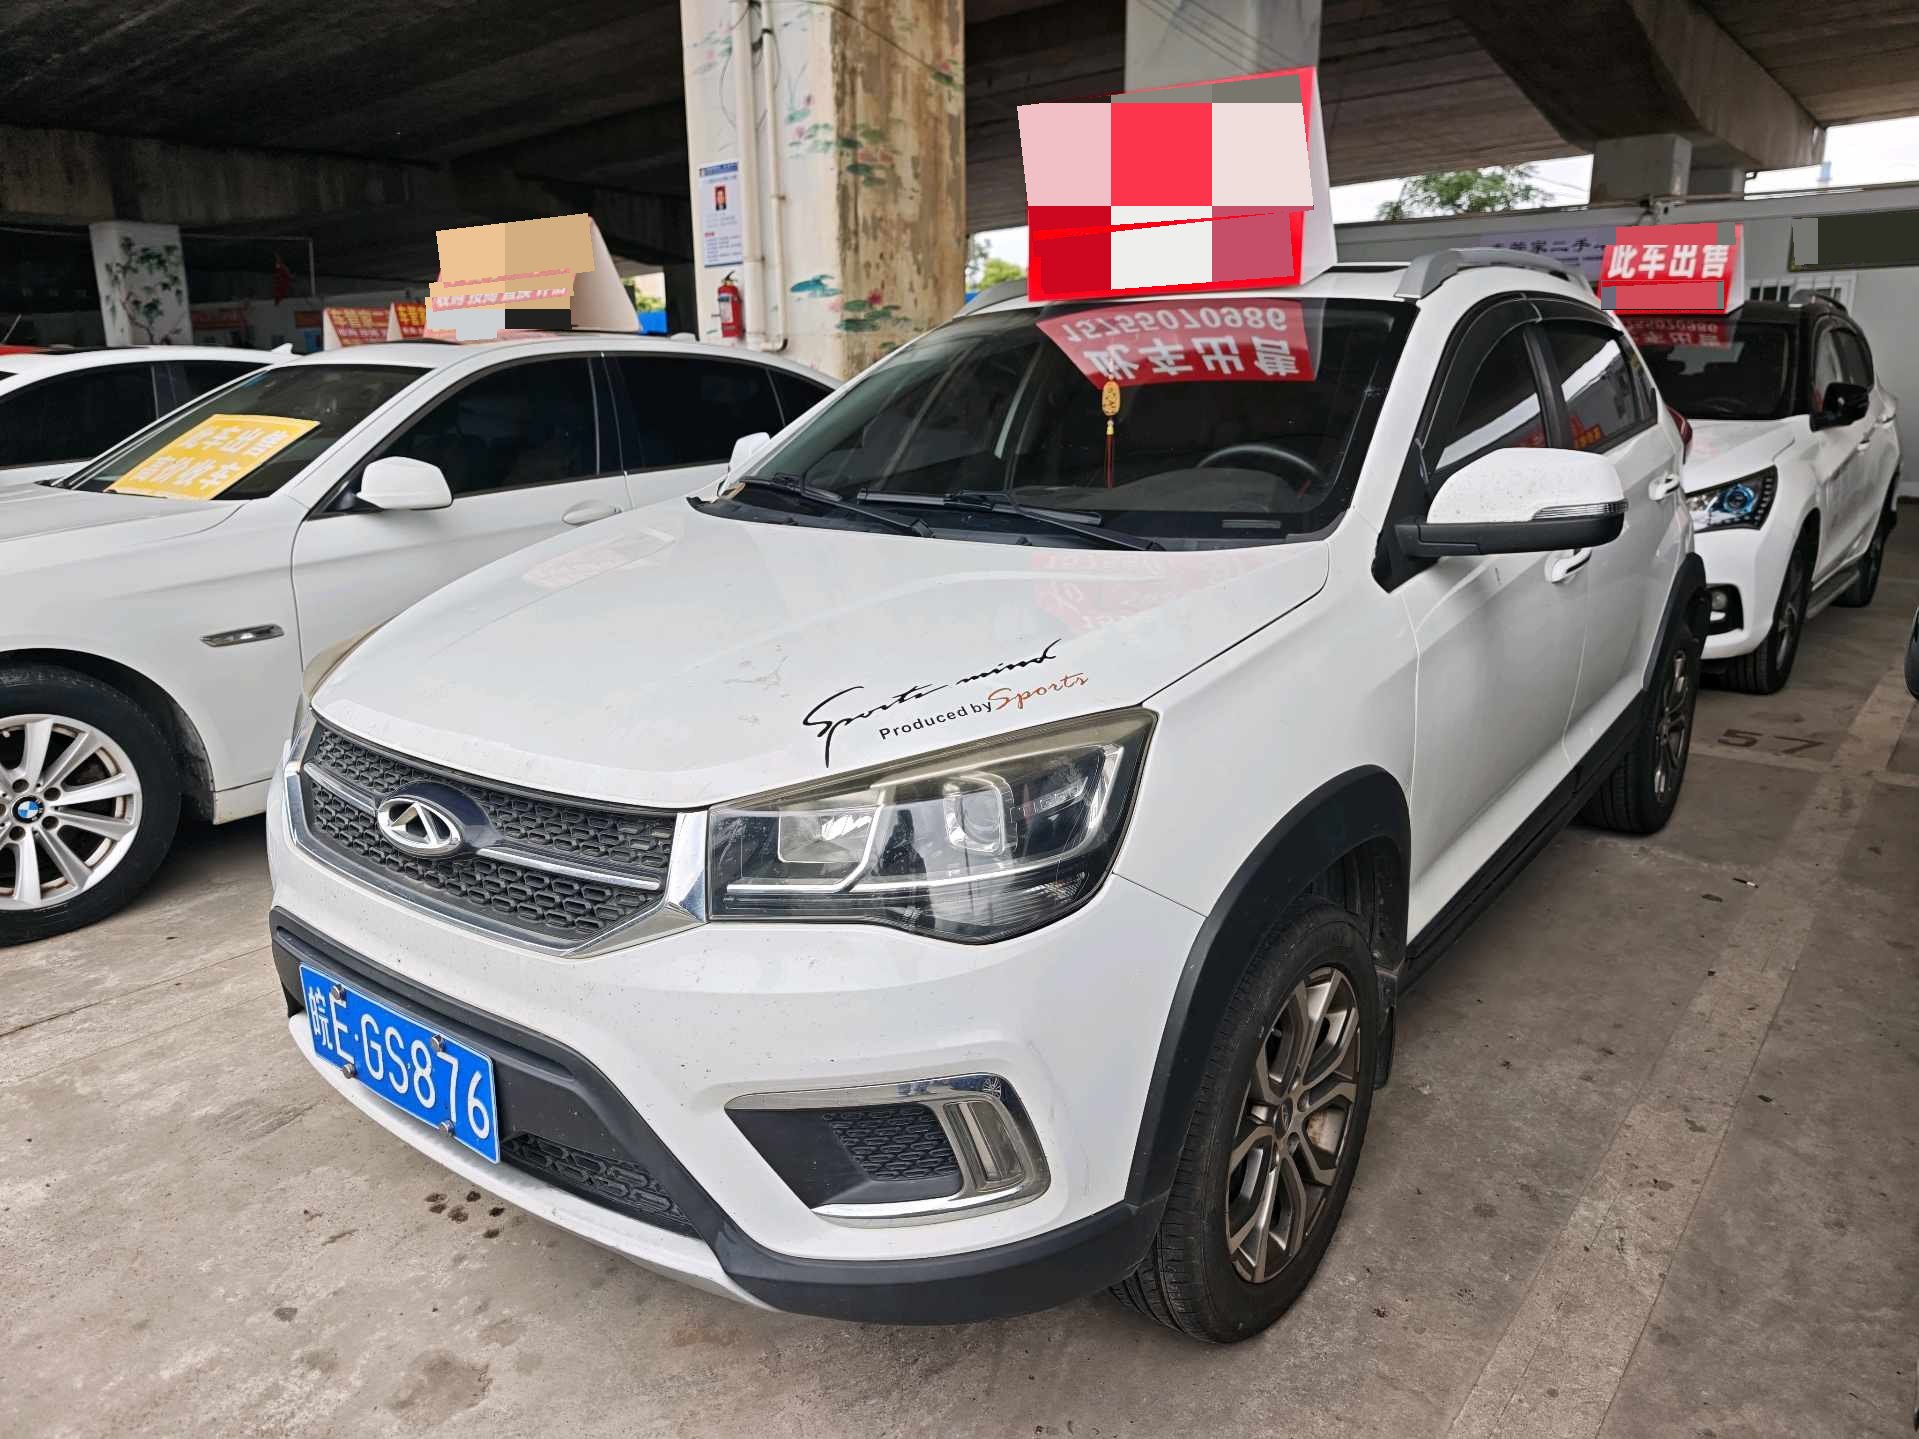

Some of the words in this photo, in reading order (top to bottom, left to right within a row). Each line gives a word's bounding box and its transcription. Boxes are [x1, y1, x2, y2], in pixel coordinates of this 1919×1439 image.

[1607, 244, 1730, 279] 此车出售
[955, 638, 1062, 685] mind
[879, 706, 968, 740] Produced
[971, 699, 993, 715] by
[987, 672, 1089, 710] Sports
[1717, 728, 1825, 755] 57
